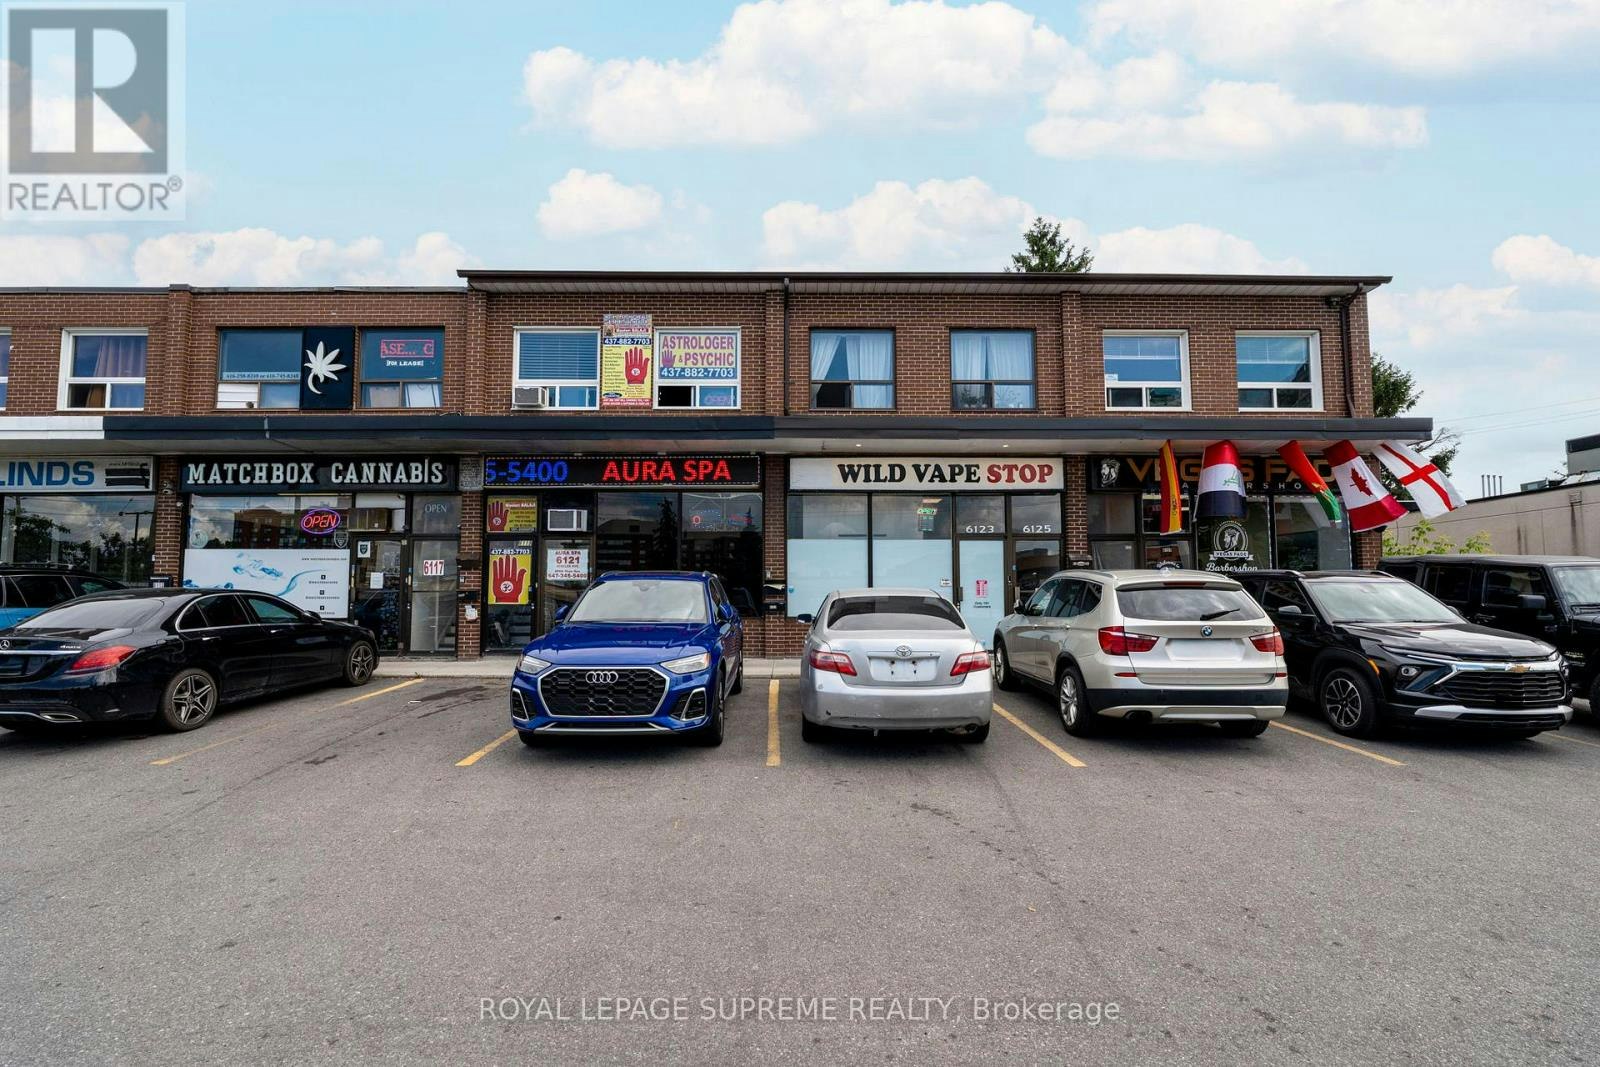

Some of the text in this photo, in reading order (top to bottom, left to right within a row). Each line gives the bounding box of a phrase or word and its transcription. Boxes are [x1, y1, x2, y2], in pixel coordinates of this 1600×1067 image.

[662, 336, 734, 350] ASTROLOGER
[684, 353, 734, 366] PSYCHIC
[661, 368, 733, 377] 437-882-7703
[187, 463, 314, 484] MATCHBOX
[331, 458, 443, 484] CANNABIS
[602, 461, 676, 481] AURA
[683, 460, 731, 481] SPA
[837, 464, 1054, 483] WILD VAPE STOP
[424, 504, 448, 513] OPEN
[303, 515, 337, 529] OPEN
[966, 525, 995, 534] 6123
[1023, 525, 1051, 534] 6125
[556, 556, 580, 564] 6121
[423, 560, 444, 575] 6117
